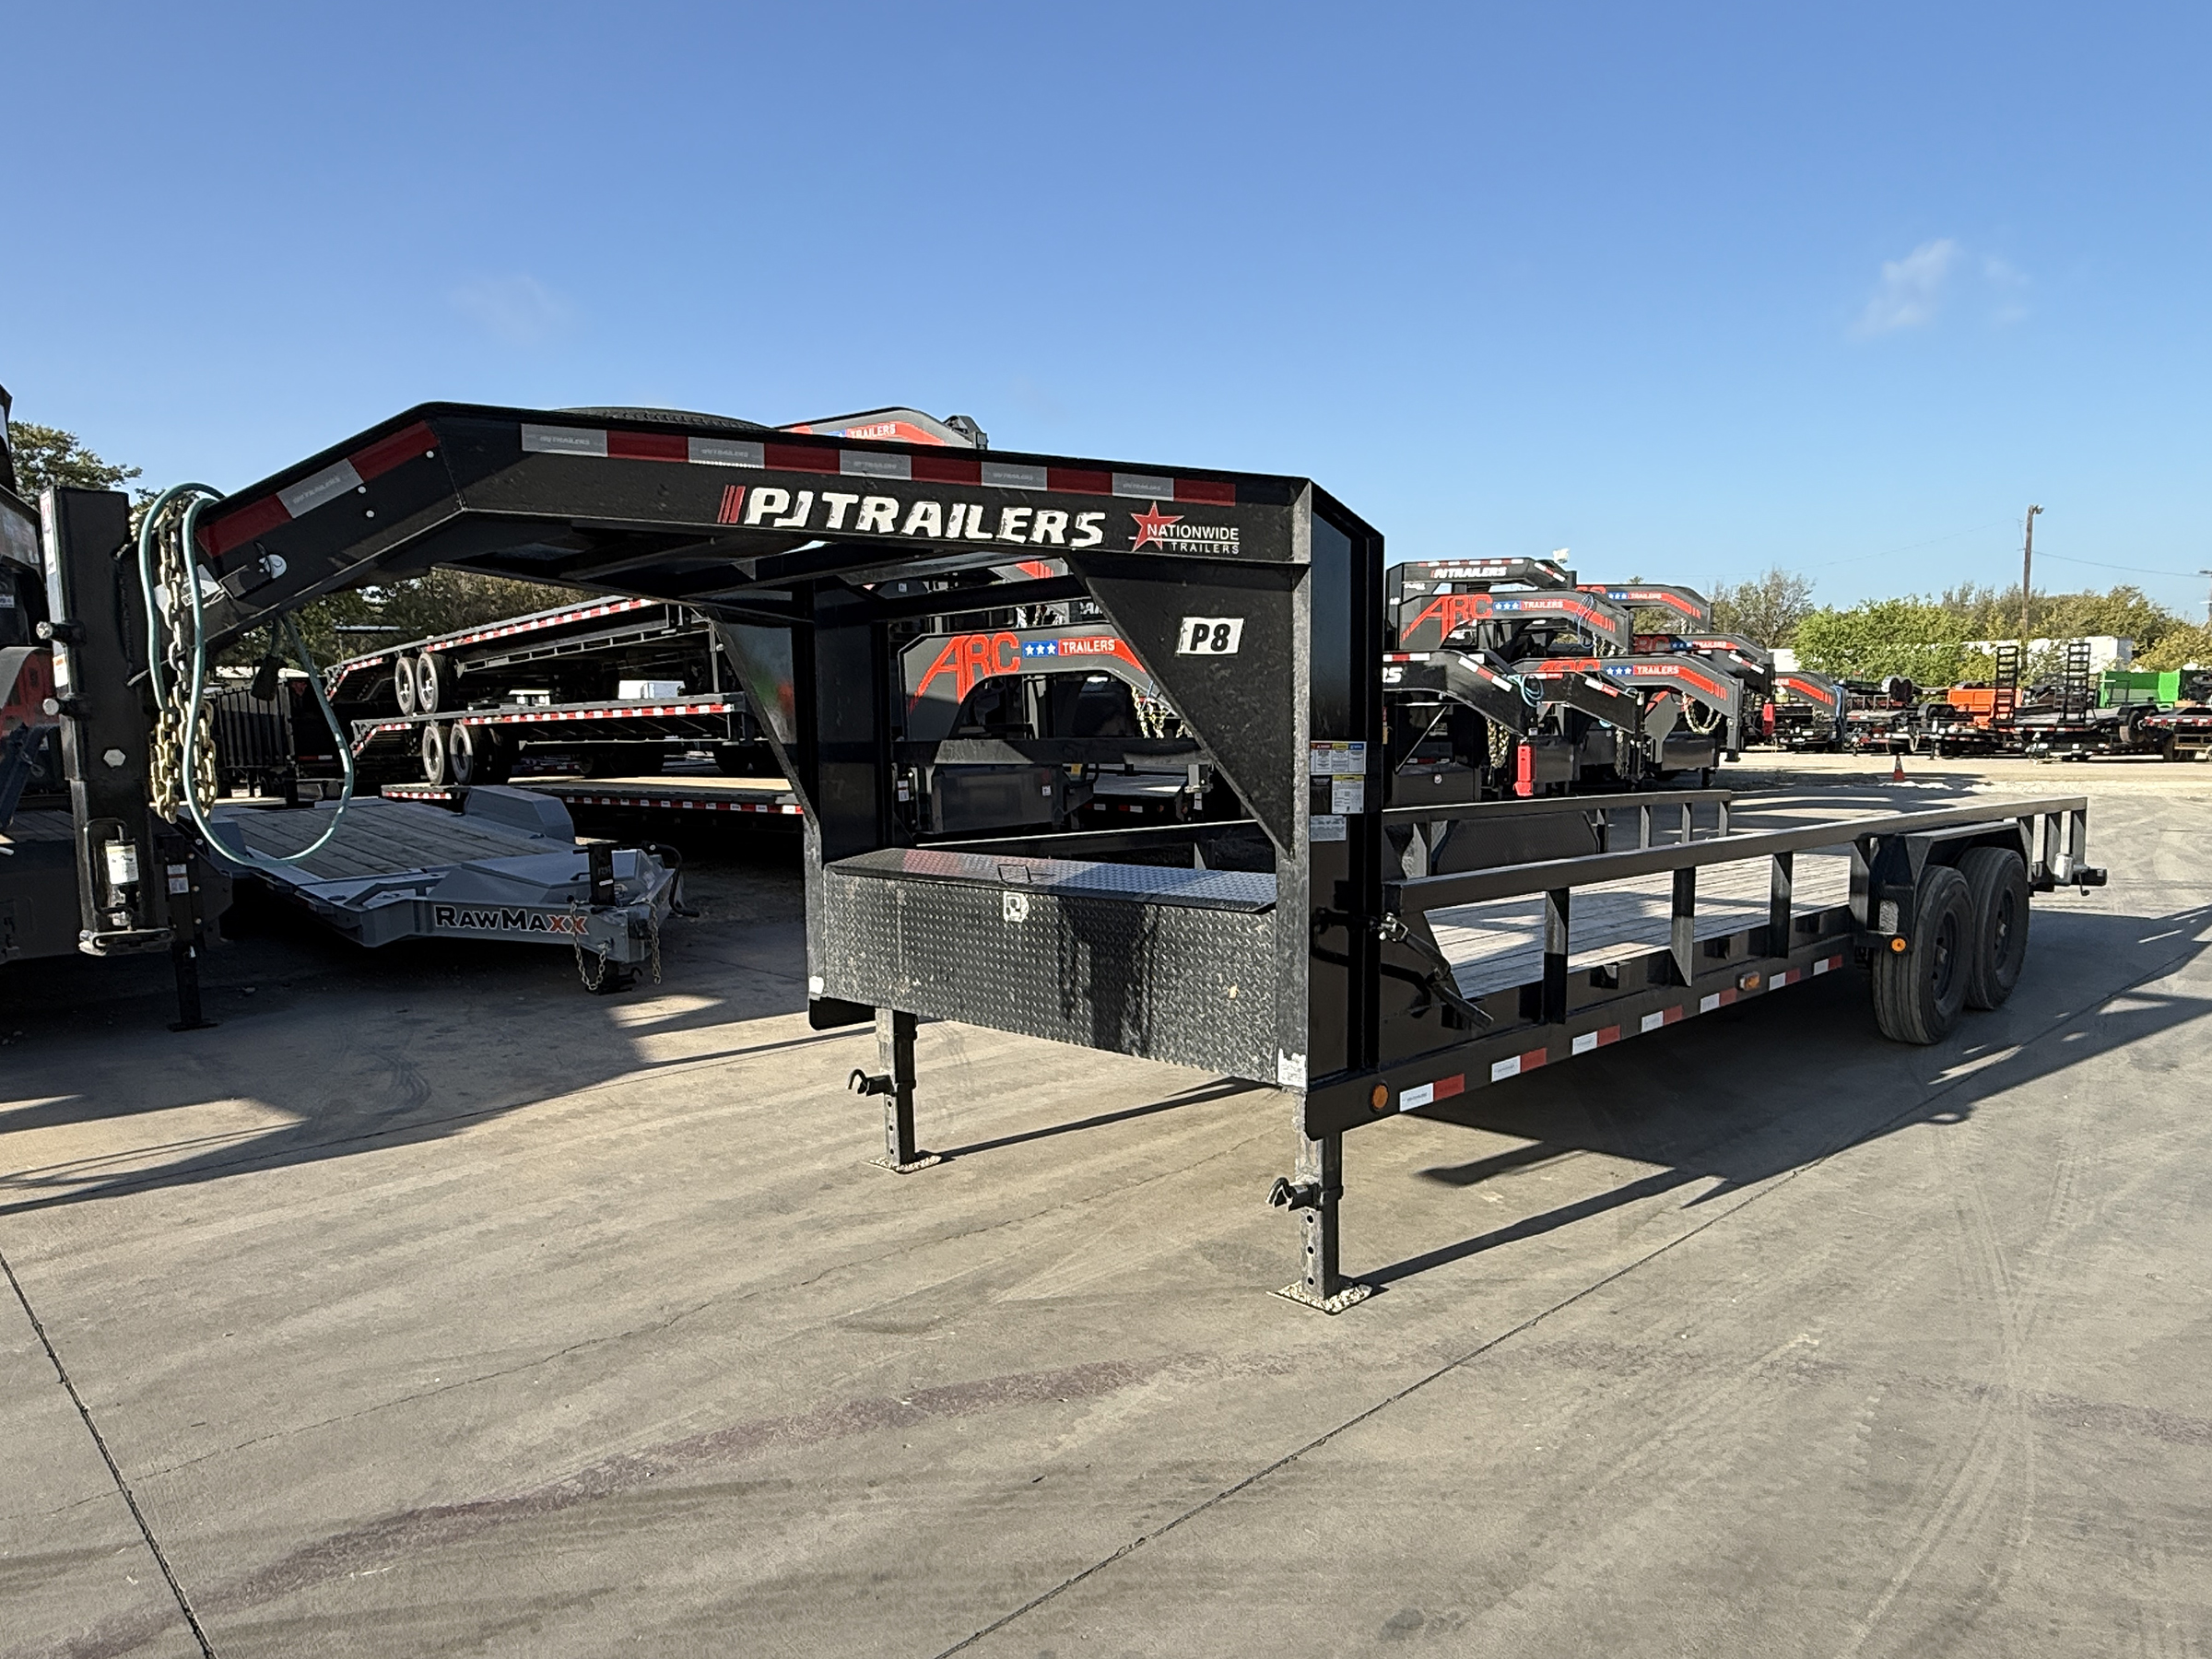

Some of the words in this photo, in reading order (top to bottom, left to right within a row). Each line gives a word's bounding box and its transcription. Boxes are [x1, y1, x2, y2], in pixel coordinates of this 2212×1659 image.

[821, 491, 1107, 548] TRAILERS
[1147, 523, 1240, 541] NATIONWIDE
[1171, 541, 1240, 555] TRAILERS
[1401, 594, 1493, 642] ARC
[1524, 601, 1564, 610] TRAILERS
[1189, 623, 1232, 653] P8
[908, 630, 1021, 713] ARC
[1062, 639, 1115, 653] TRAILERS
[1637, 665, 1680, 675] TRAILERS
